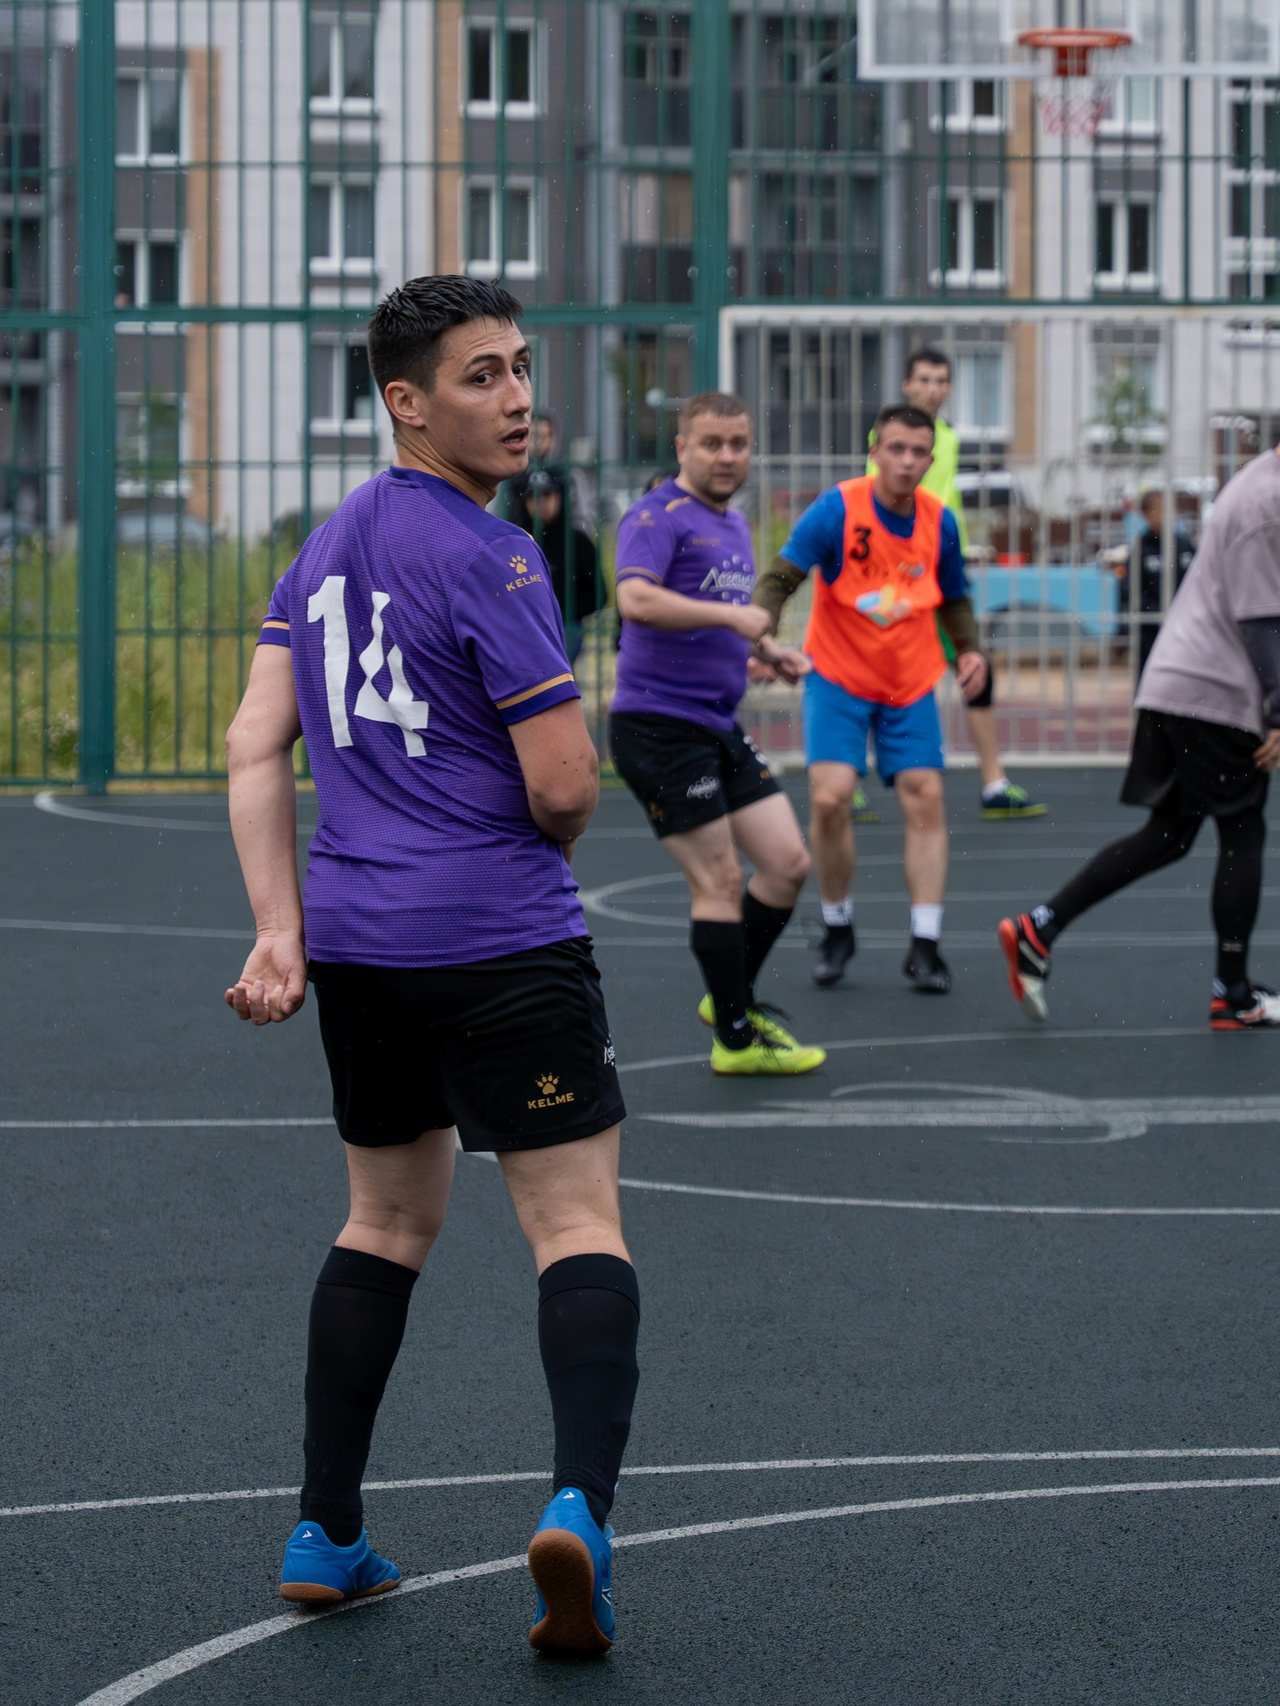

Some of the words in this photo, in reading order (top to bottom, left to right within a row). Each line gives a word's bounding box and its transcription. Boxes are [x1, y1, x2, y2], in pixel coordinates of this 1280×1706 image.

[850, 526, 872, 561] 3
[505, 573, 543, 592] KELME
[307, 576, 429, 757] 14
[527, 1092, 575, 1110] KELME
